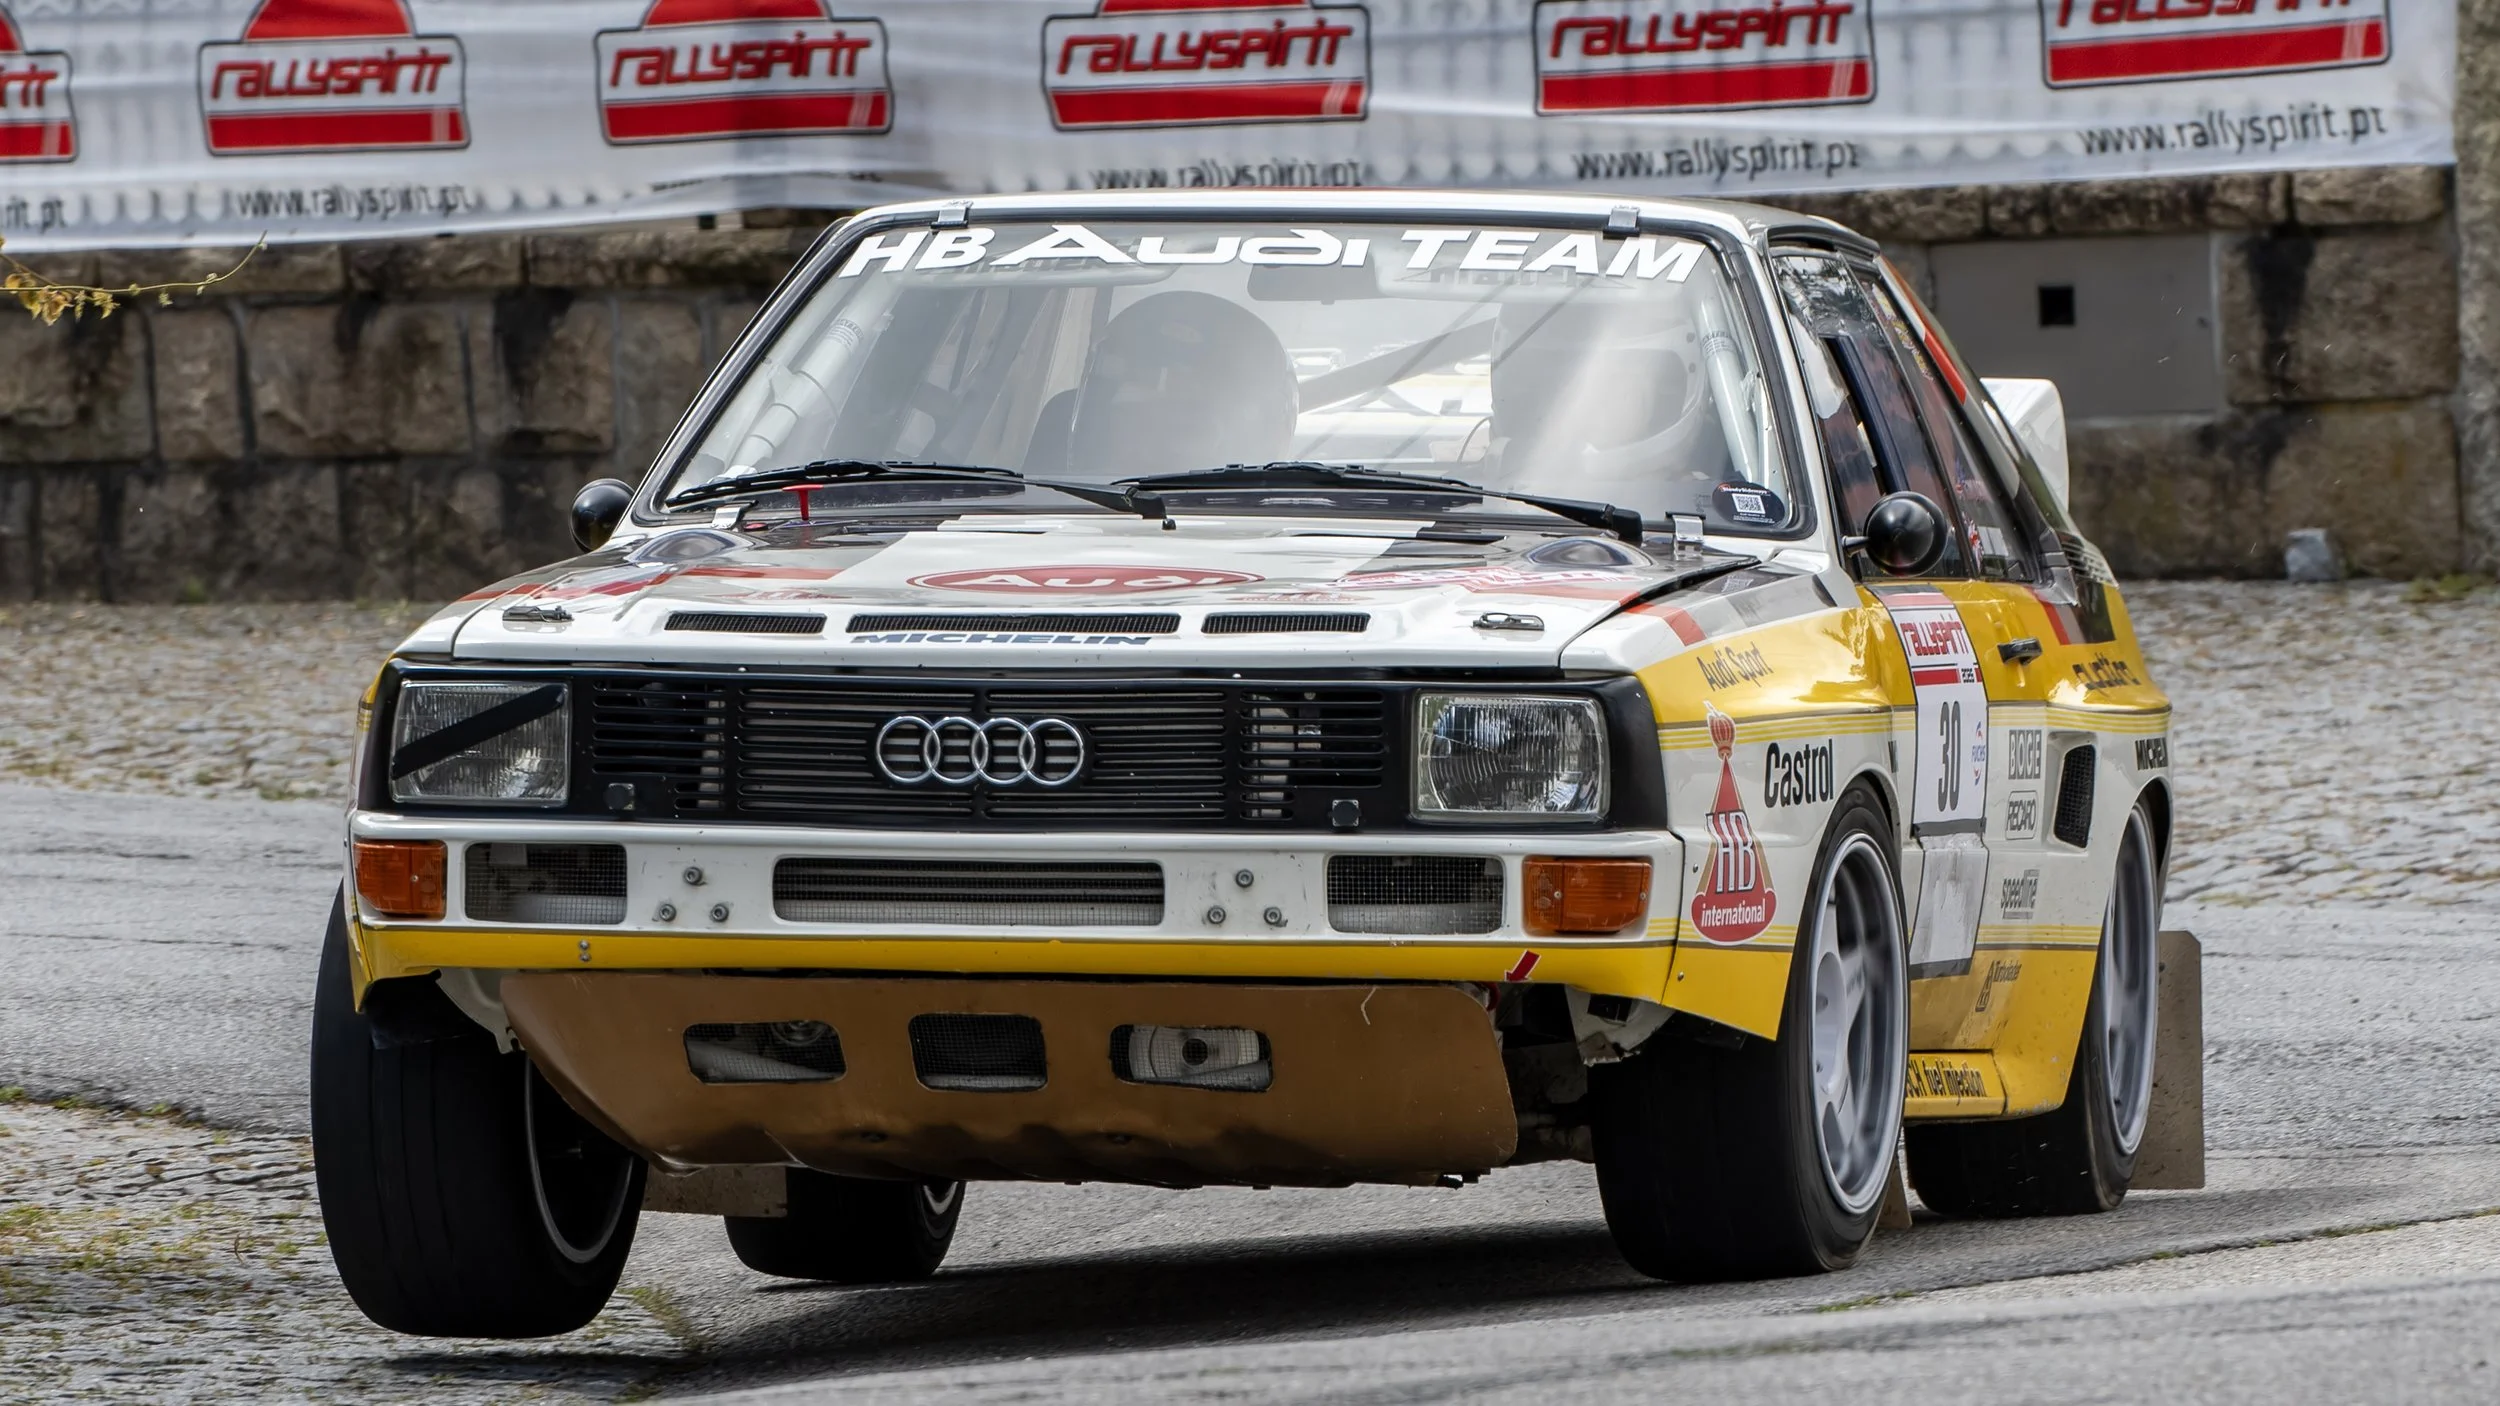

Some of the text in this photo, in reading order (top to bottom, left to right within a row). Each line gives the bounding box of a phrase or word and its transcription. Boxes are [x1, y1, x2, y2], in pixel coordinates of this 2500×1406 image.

[2078, 102, 2388, 154] www.rallyspirit.pt
[1573, 137, 1860, 183] www.rallyspirit.pt
[838, 228, 996, 278] HB
[989, 223, 1371, 269] Audi
[1401, 229, 1706, 282] TEAM
[964, 573, 1226, 588] Audi
[850, 633, 1152, 646] MICHELIN
[1697, 642, 1774, 692] Audi Sport
[1764, 738, 1834, 809] Castrol
[1937, 700, 1961, 813] 30
[2008, 729, 2042, 780] BOGE
[2005, 799, 2037, 831] RECARO
[1704, 809, 1756, 895] HB
[1701, 899, 1766, 928] international
[1922, 1059, 1947, 1096] fuel
[1941, 1060, 1988, 1107] injection
